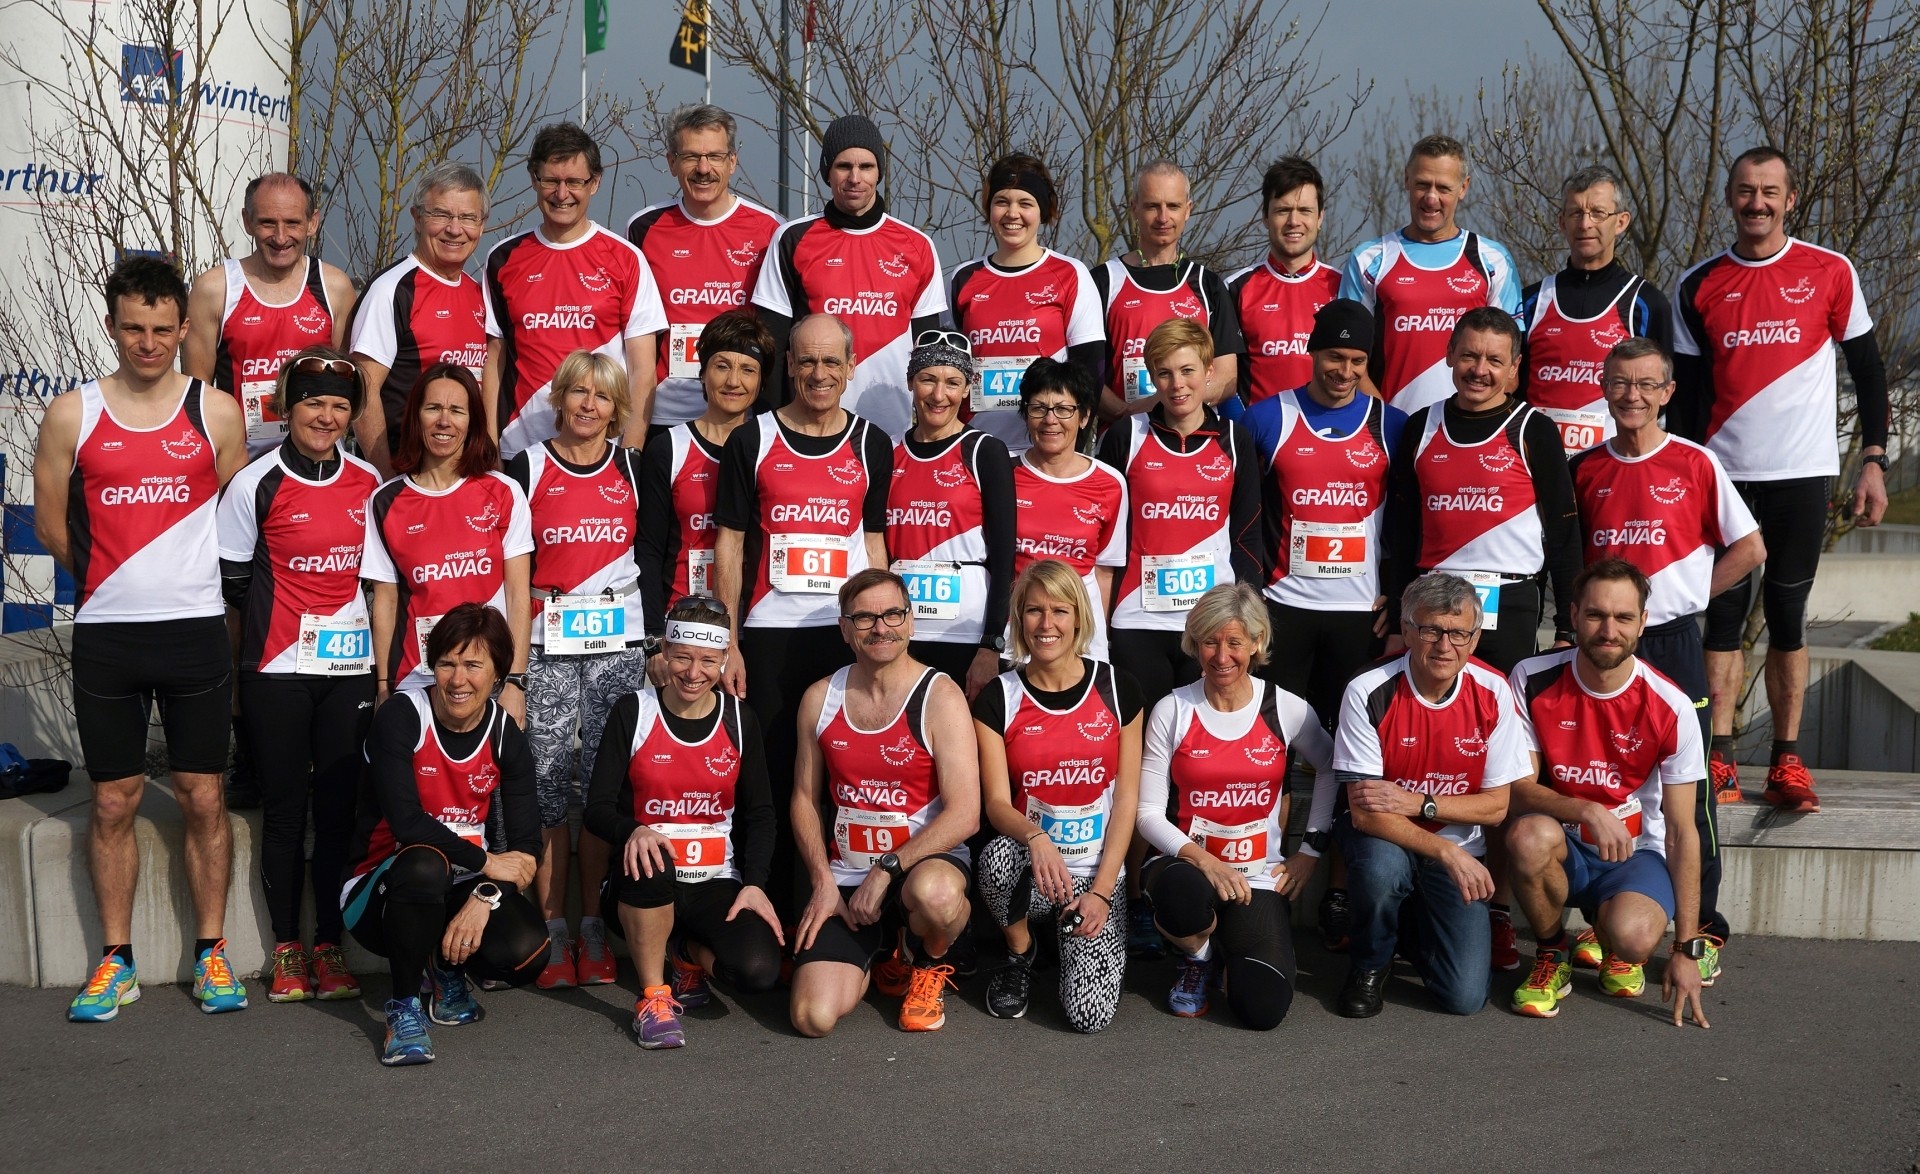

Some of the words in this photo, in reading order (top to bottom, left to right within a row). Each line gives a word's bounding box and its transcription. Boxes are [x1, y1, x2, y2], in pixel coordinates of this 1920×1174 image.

[121, 74, 171, 98] AXA
[704, 281, 730, 290] erdgas
[670, 288, 746, 306] GRAVAG
[858, 291, 882, 299] erdgas
[555, 304, 580, 312] erdgas
[824, 298, 898, 316] GRAVAG
[1428, 307, 1456, 315] erdgas
[522, 313, 596, 329] GRAVAG
[998, 319, 1024, 327] erdgas
[1394, 315, 1462, 332] GRAVA
[1756, 320, 1784, 328] erdgas
[969, 326, 1041, 346] GRAVAG
[1294, 332, 1310, 340] erdg
[1723, 327, 1800, 348] GRAVAG
[466, 342, 482, 350] erdgas
[1262, 340, 1310, 356] GRAV
[242, 358, 286, 376] GRA
[1569, 360, 1594, 368] erdgas
[996, 398, 1023, 407] Jessic
[141, 476, 173, 485] erdgas
[1326, 481, 1354, 490] erdgas
[1458, 486, 1486, 494] erdgas
[100, 485, 190, 506] GRAVAG
[1292, 488, 1368, 507] GRAVAG
[808, 496, 836, 506] erdgas
[910, 500, 936, 508] erdgas
[1428, 494, 1504, 512] GRAVAG
[770, 504, 850, 526] GRAVAG
[1141, 502, 1220, 520] GRAVAG
[580, 517, 610, 526] erdgas
[1624, 520, 1650, 528] erdgas
[542, 526, 628, 545] GRAVAG
[1044, 534, 1074, 544] erdgas
[1592, 528, 1667, 546] GRAVAG
[330, 544, 356, 554] erdgas
[1328, 539, 1343, 561] 2
[444, 550, 474, 560] erdgas
[803, 550, 830, 574] 61
[412, 557, 492, 584] GRAVAG
[1318, 565, 1352, 574] Mathias
[808, 579, 830, 588] Berni
[1164, 570, 1207, 593] 503
[907, 577, 951, 600] 416
[1172, 598, 1200, 606] Theres
[918, 605, 938, 614] Rina
[570, 611, 614, 634] 461
[682, 630, 724, 644] odlo
[326, 632, 364, 657] 481
[584, 640, 607, 650] Edith
[328, 662, 364, 672] Jeannine
[1059, 758, 1090, 767] erdgas
[1022, 767, 1106, 788] GRAVAG
[1426, 772, 1454, 781] erdgas
[861, 779, 888, 788] erdgas
[1226, 781, 1256, 790] erdgas
[682, 791, 711, 800] erdgas
[836, 784, 908, 806] GRAVAG
[1189, 788, 1271, 808] GRAVAG
[442, 806, 470, 815] erdgas
[1048, 819, 1094, 842] 438
[862, 828, 893, 850] 19
[686, 840, 702, 864] 9
[1220, 839, 1253, 861] 49
[870, 856, 881, 866] Fe
[677, 869, 708, 879] Denise
